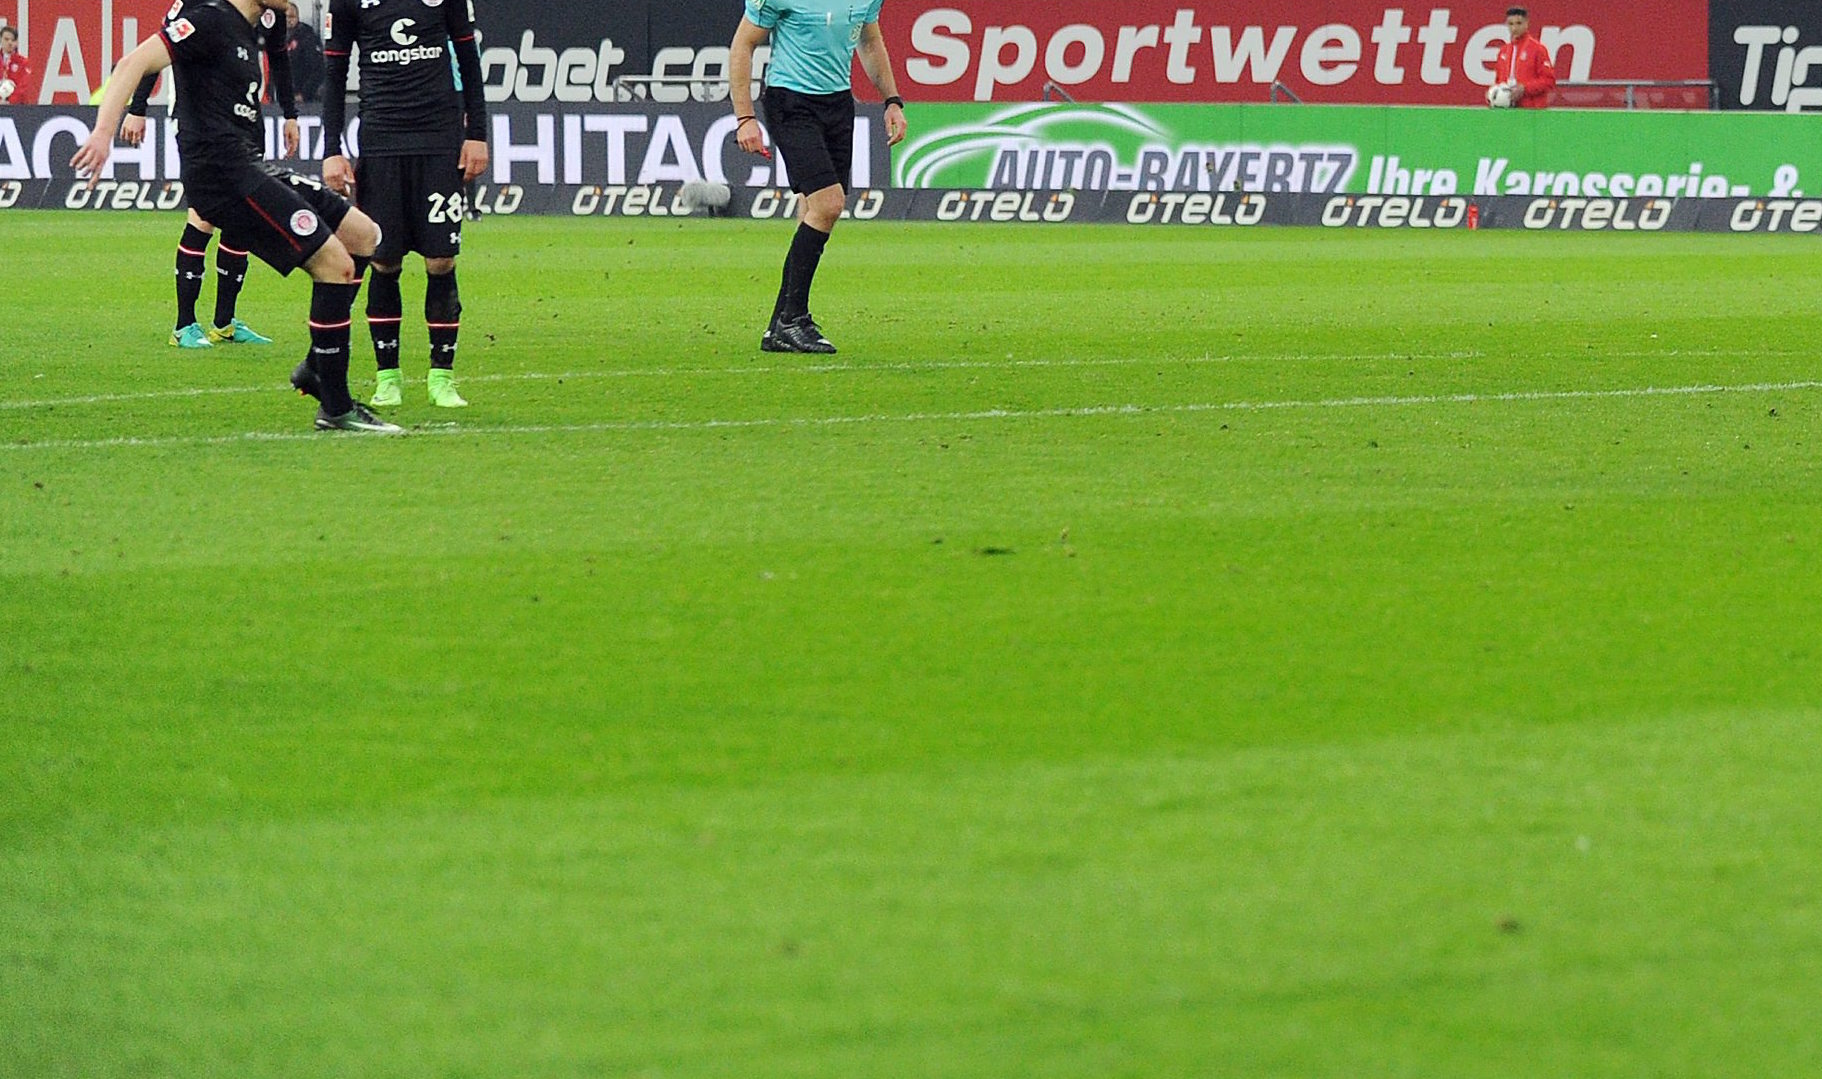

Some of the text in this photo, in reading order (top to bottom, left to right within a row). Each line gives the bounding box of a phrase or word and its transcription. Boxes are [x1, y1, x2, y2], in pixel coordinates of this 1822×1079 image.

[371, 44, 444, 66] congstar
[906, 8, 1596, 101] Sportwetten
[492, 113, 872, 189] HITACI
[1367, 155, 1458, 196] Ihre
[427, 191, 463, 223] 28
